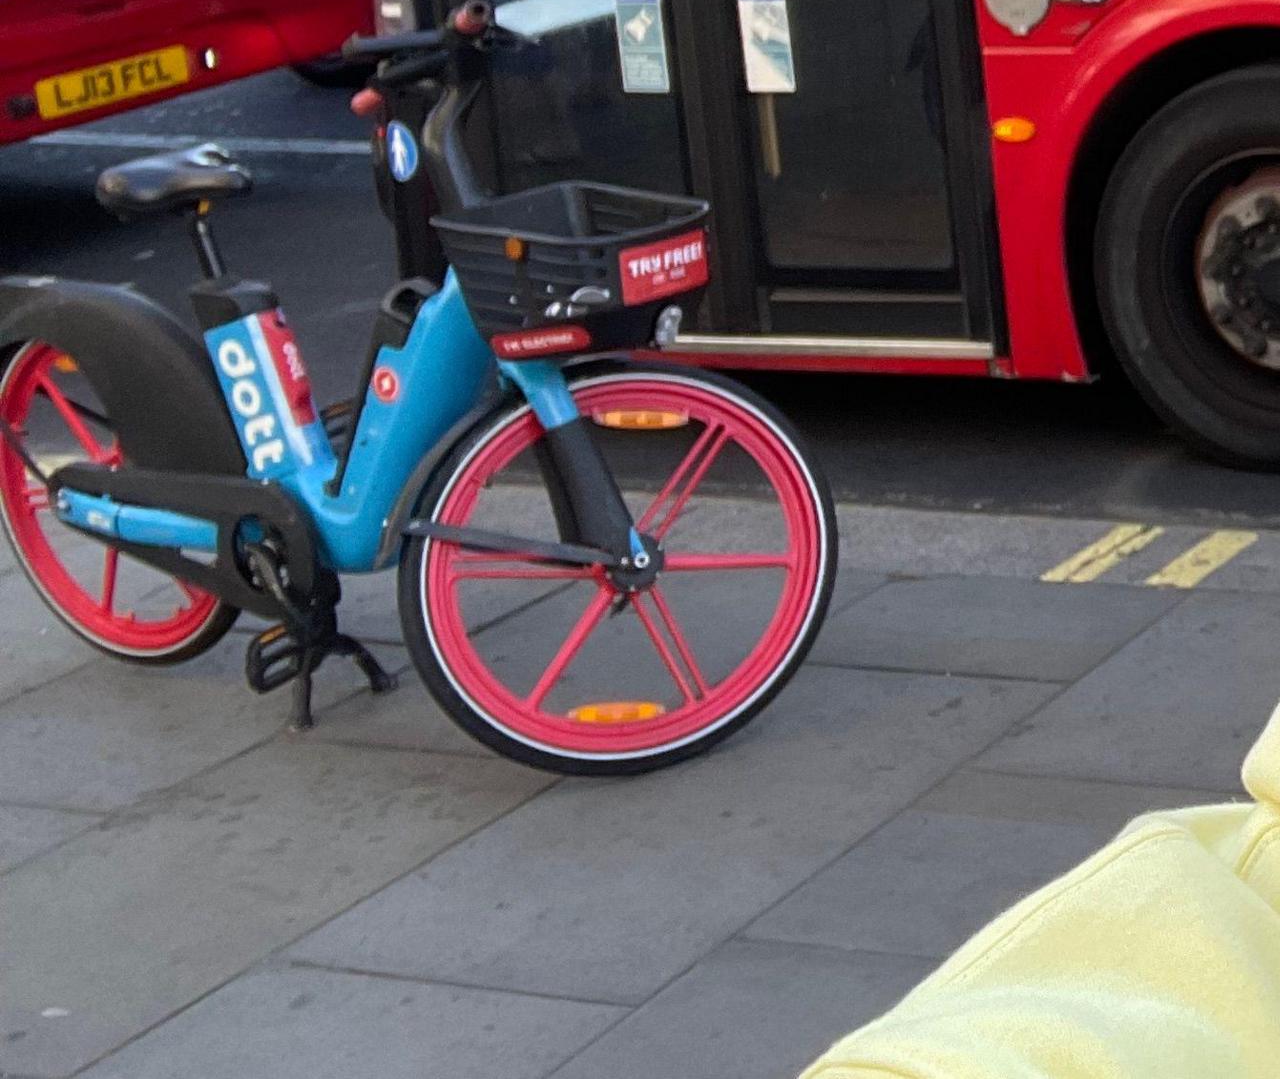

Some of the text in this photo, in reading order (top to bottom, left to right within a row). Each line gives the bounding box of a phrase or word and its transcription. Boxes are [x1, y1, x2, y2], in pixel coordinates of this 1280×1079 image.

[54, 57, 172, 108] LJ13 FCL
[628, 253, 662, 279] TRY
[218, 338, 284, 472] dott
